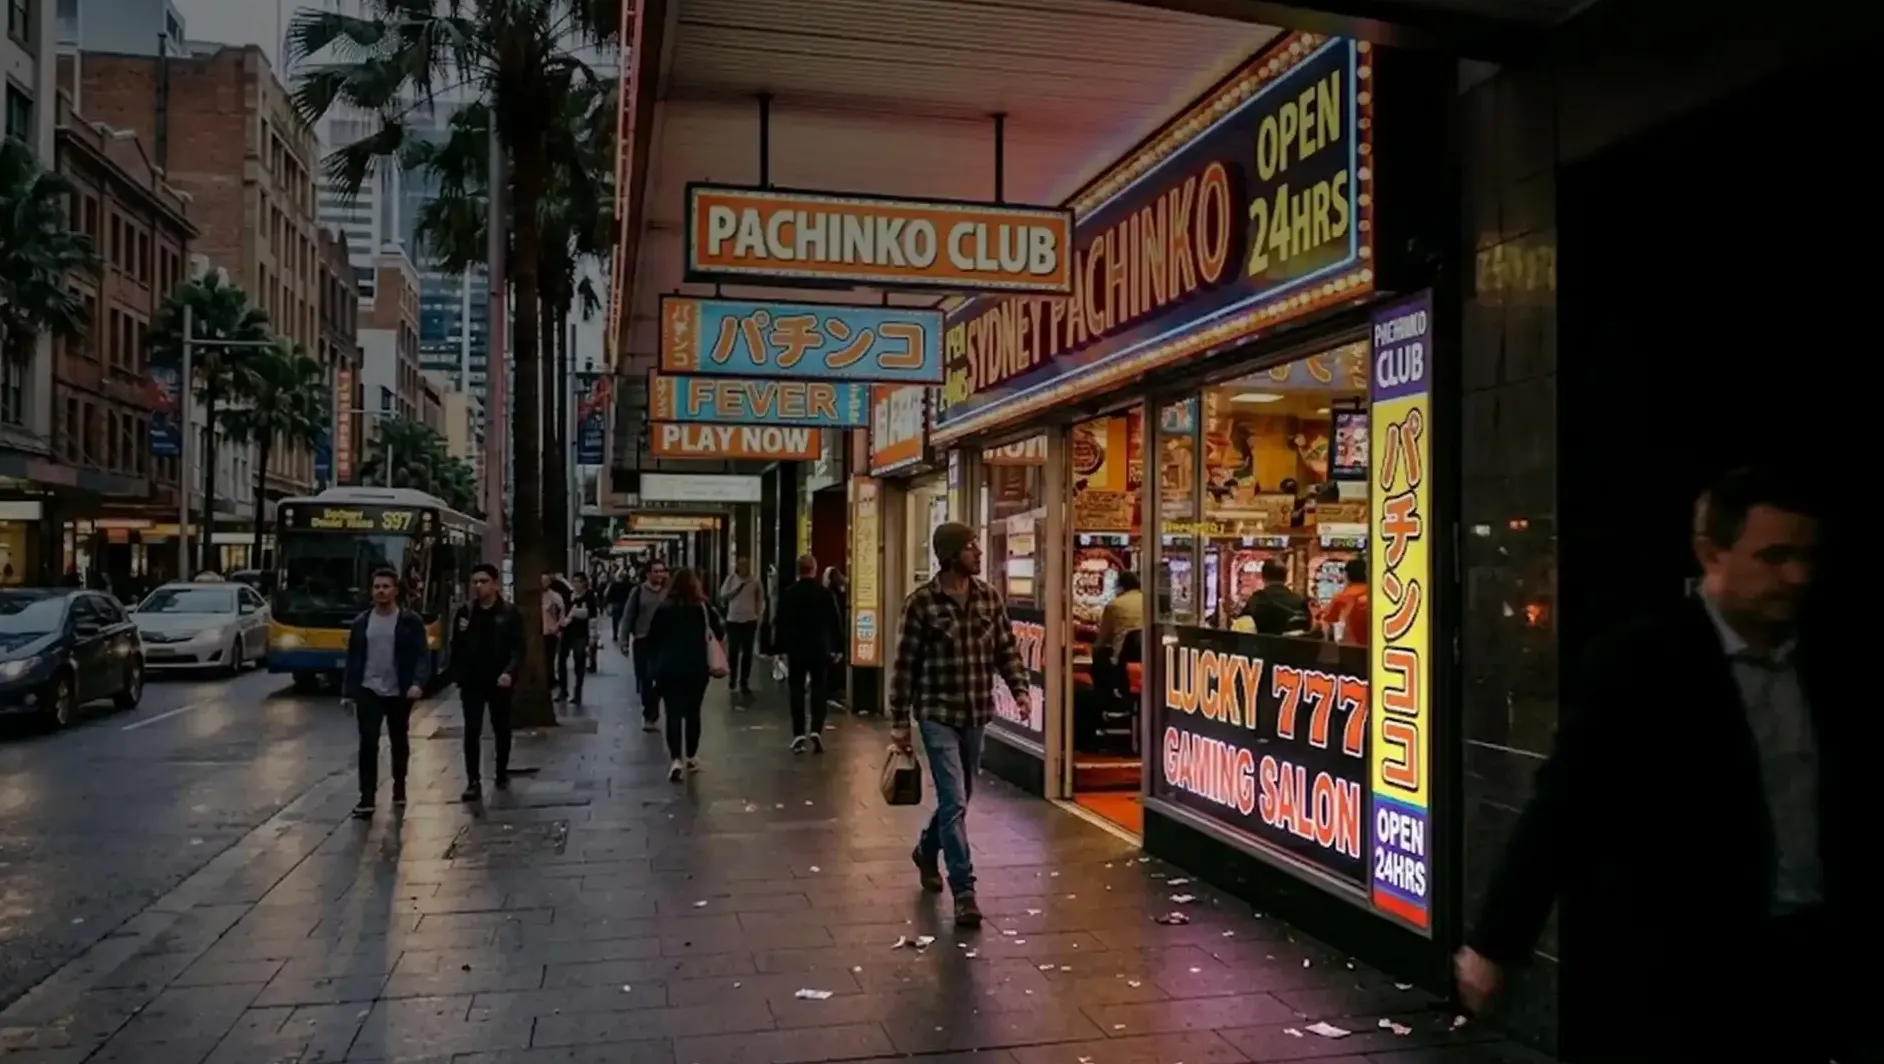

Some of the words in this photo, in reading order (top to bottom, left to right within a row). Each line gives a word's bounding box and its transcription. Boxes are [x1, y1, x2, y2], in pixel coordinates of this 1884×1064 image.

[1256, 69, 1341, 182] OPEN
[708, 205, 938, 269] PACHINKO
[948, 221, 1058, 276] CLUB
[1248, 169, 1348, 277] 24HRS
[966, 296, 1042, 394] SYDNEY
[1049, 161, 1231, 357] PACHINKO
[710, 308, 925, 370] パチンコ
[1376, 341, 1424, 389] CLUB
[687, 380, 839, 419] FEVER
[661, 425, 734, 452] PLAY
[740, 427, 809, 454] NOW
[1380, 407, 1423, 792] パチンココ
[1165, 645, 1264, 730] LUCKY
[1272, 664, 1369, 758] 777
[1163, 726, 1255, 816] GAMING
[1259, 754, 1361, 860] SALON
[1376, 808, 1424, 856] OPEN
[1374, 850, 1427, 897] 24HRS
